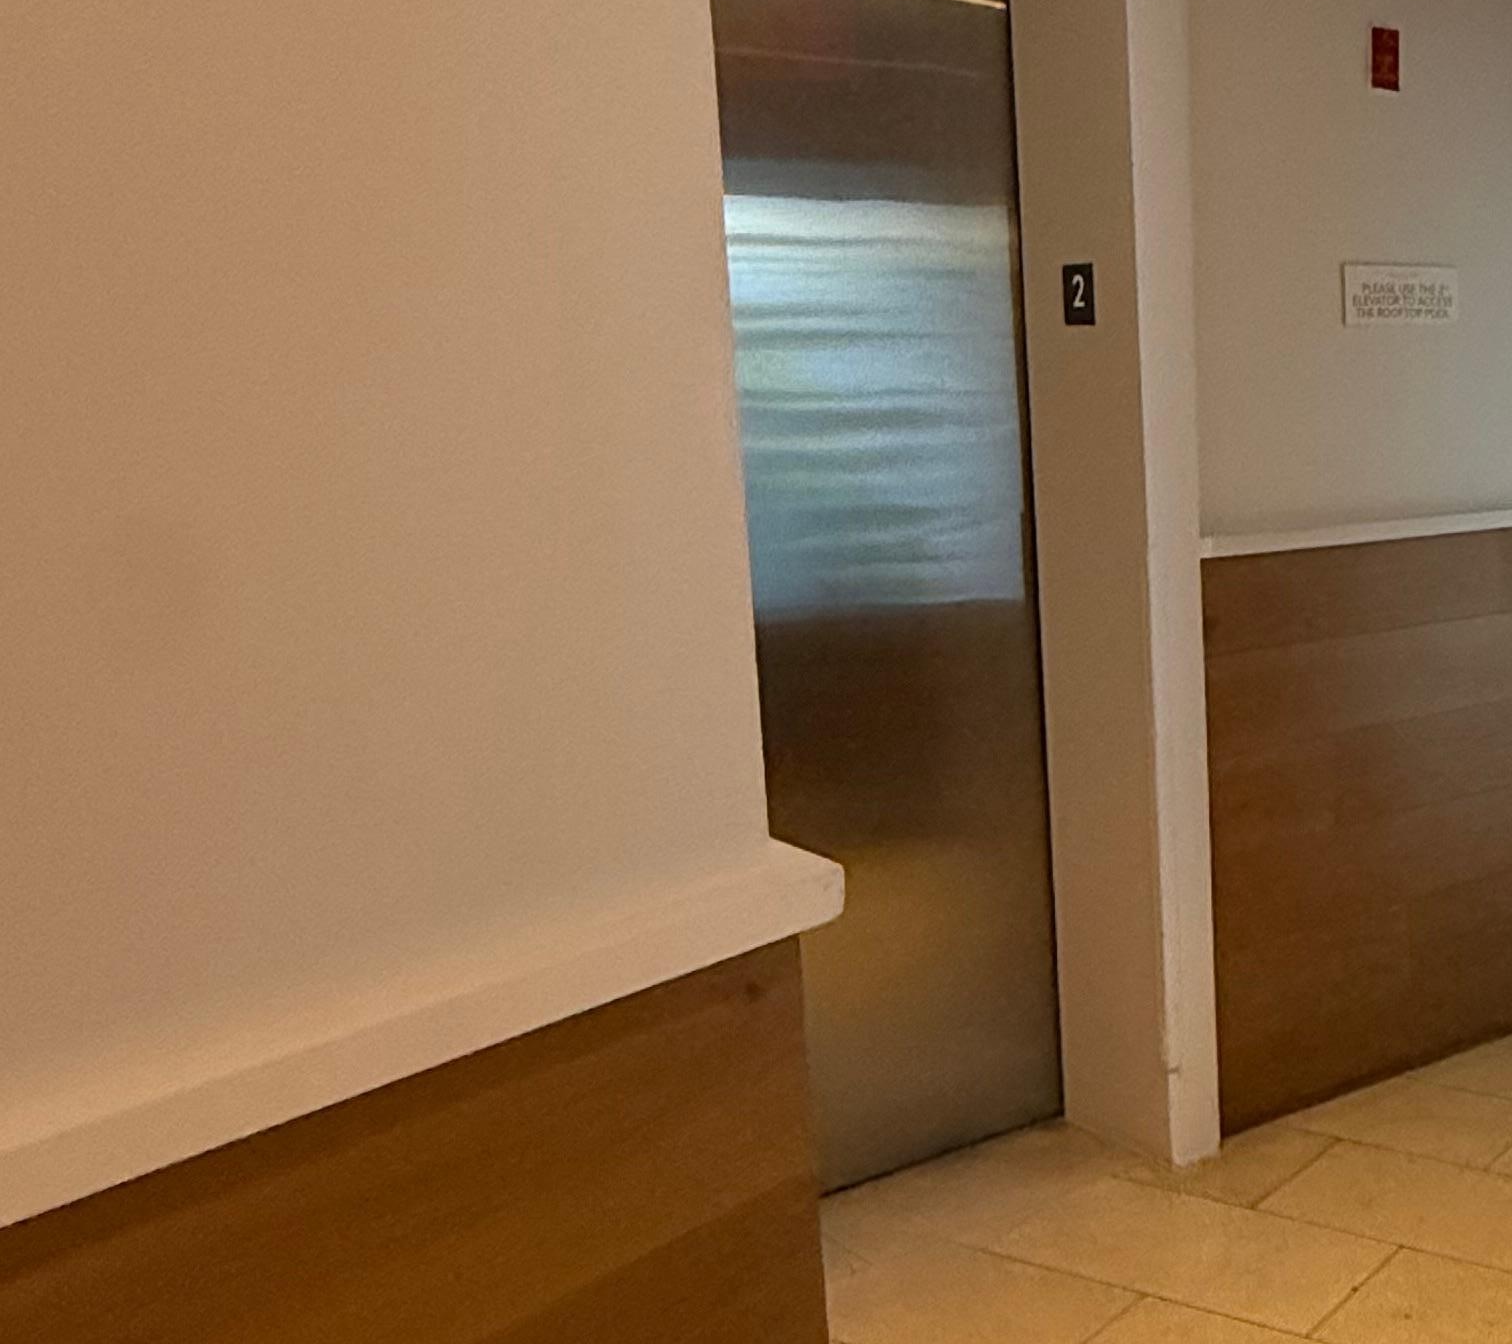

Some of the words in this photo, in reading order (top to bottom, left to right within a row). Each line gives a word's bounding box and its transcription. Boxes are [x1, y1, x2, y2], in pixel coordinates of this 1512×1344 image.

[1072, 274, 1085, 308] 2
[1361, 282, 1396, 294] PLEASE
[1352, 294, 1400, 307] ELEVATOR
